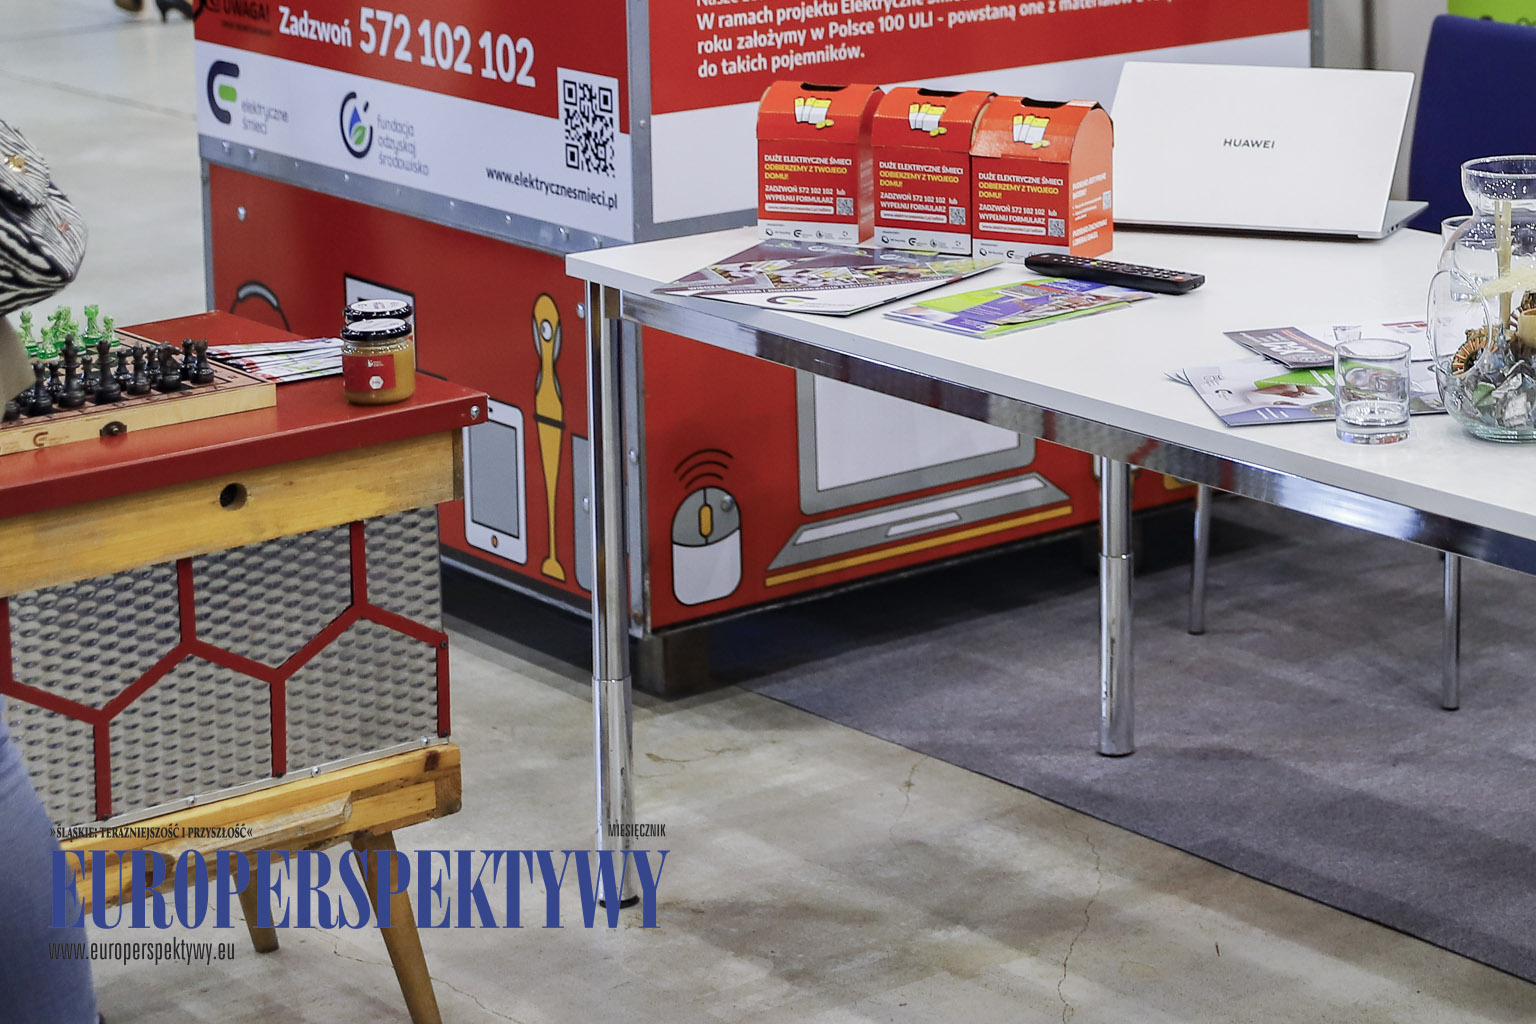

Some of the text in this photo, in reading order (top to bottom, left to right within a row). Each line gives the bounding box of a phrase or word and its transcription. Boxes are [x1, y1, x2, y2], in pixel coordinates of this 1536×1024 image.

[697, 12, 715, 31] W
[718, 6, 773, 28] ramach
[776, 0, 838, 25] projektu
[697, 34, 732, 54] roku
[736, 26, 806, 51] założymy
[810, 26, 825, 41] w
[828, 18, 875, 39] Polsce
[878, 15, 905, 34] 100
[908, 11, 934, 30] ULI
[948, 1, 1016, 28] powstaną
[1019, 1, 1045, 17] one
[1048, 0, 1056, 13] z
[278, 6, 536, 87] Zadzwoń 572 102 102
[697, 44, 865, 78] do takich pojemników.
[241, 100, 289, 123] elektryczne
[242, 114, 268, 136] śmieci
[377, 114, 414, 139] fundacja
[377, 131, 417, 158] odzyskaj
[1223, 138, 1275, 148] HUAWEI
[378, 149, 429, 177] środowisko
[485, 166, 618, 211] www.elektrycznesmieci.pl
